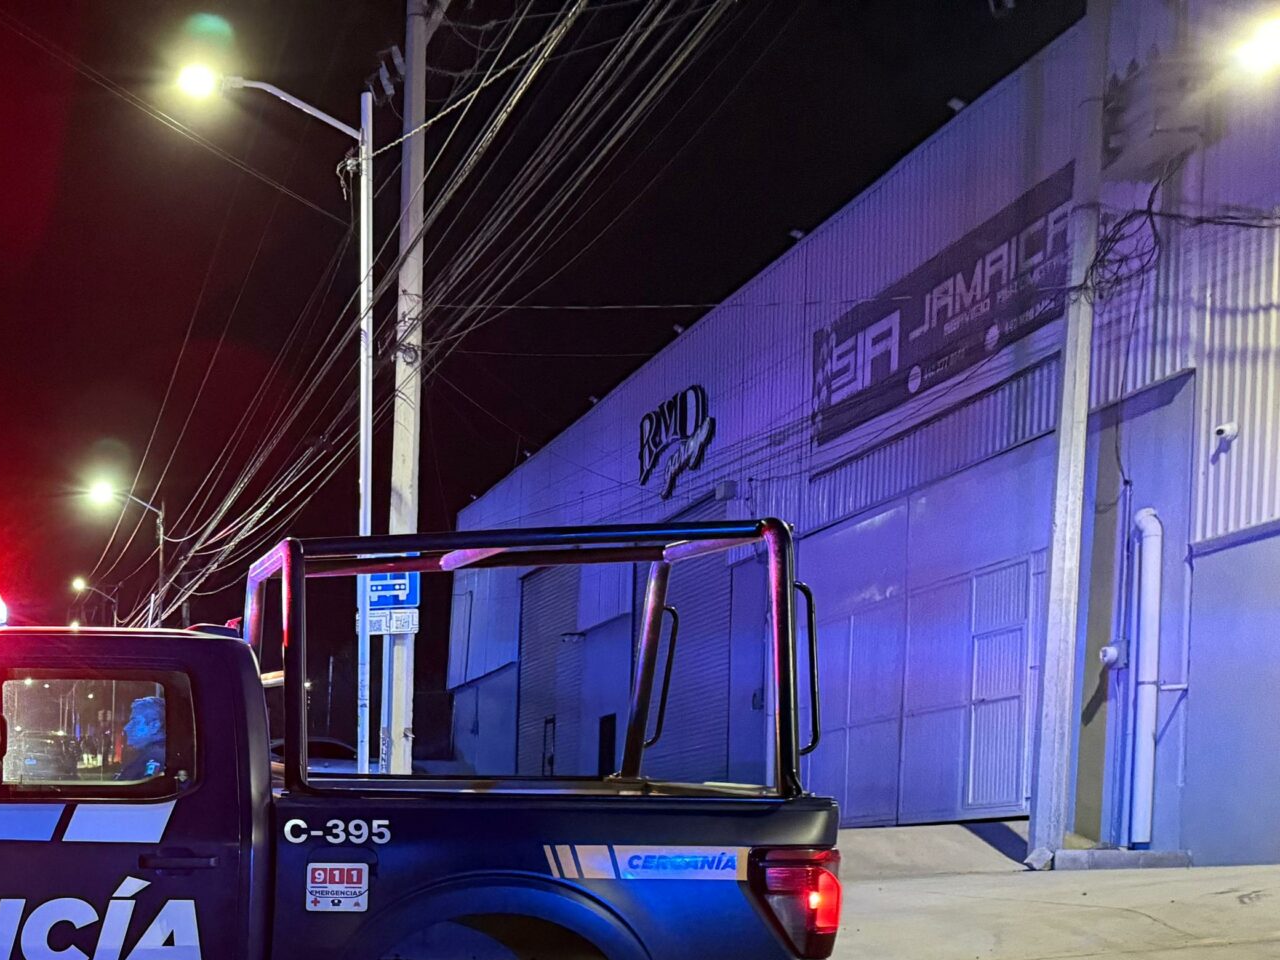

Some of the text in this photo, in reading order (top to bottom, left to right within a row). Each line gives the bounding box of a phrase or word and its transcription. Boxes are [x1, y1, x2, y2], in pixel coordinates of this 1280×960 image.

[909, 200, 1072, 341] JAMAICA
[283, 818, 391, 844] C-395
[314, 869, 358, 883] 911
